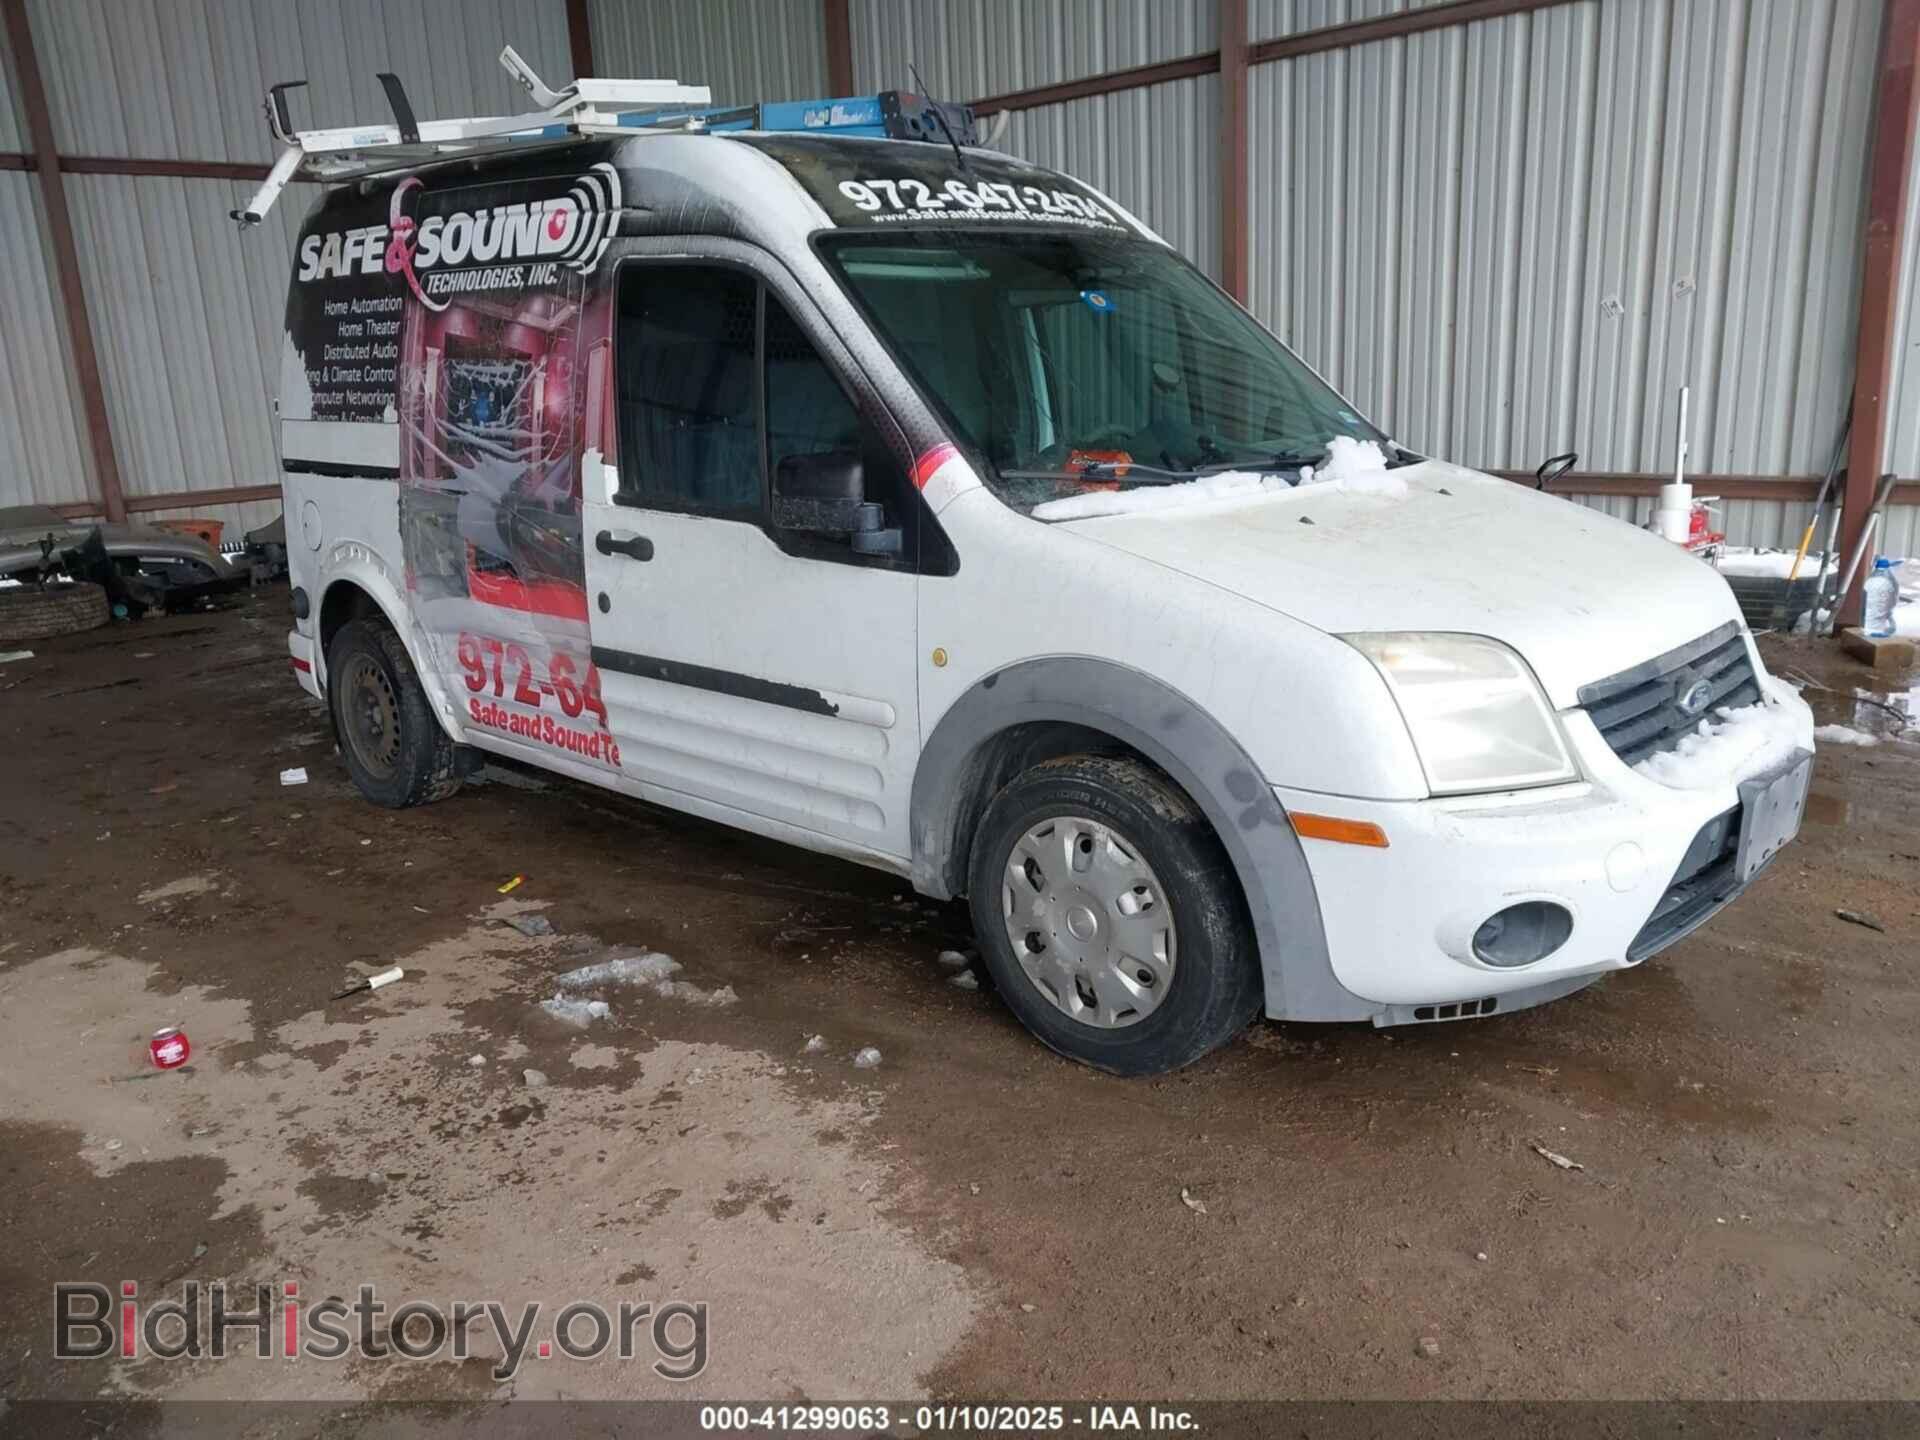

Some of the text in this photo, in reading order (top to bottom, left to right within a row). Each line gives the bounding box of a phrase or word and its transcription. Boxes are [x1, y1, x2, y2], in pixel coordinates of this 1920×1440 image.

[839, 179, 1117, 223] 972-647-2474
[299, 224, 388, 282] SAFE
[414, 197, 577, 268] SOUND
[427, 263, 558, 294] TECHNOLOGIES, INC.
[325, 295, 402, 315] Home Automation
[338, 319, 401, 337] Home Theater
[324, 342, 398, 360] Distributed Audio
[322, 365, 330, 383] &
[331, 365, 361, 383] Climate
[363, 364, 398, 382] Control
[346, 387, 396, 407] Networking
